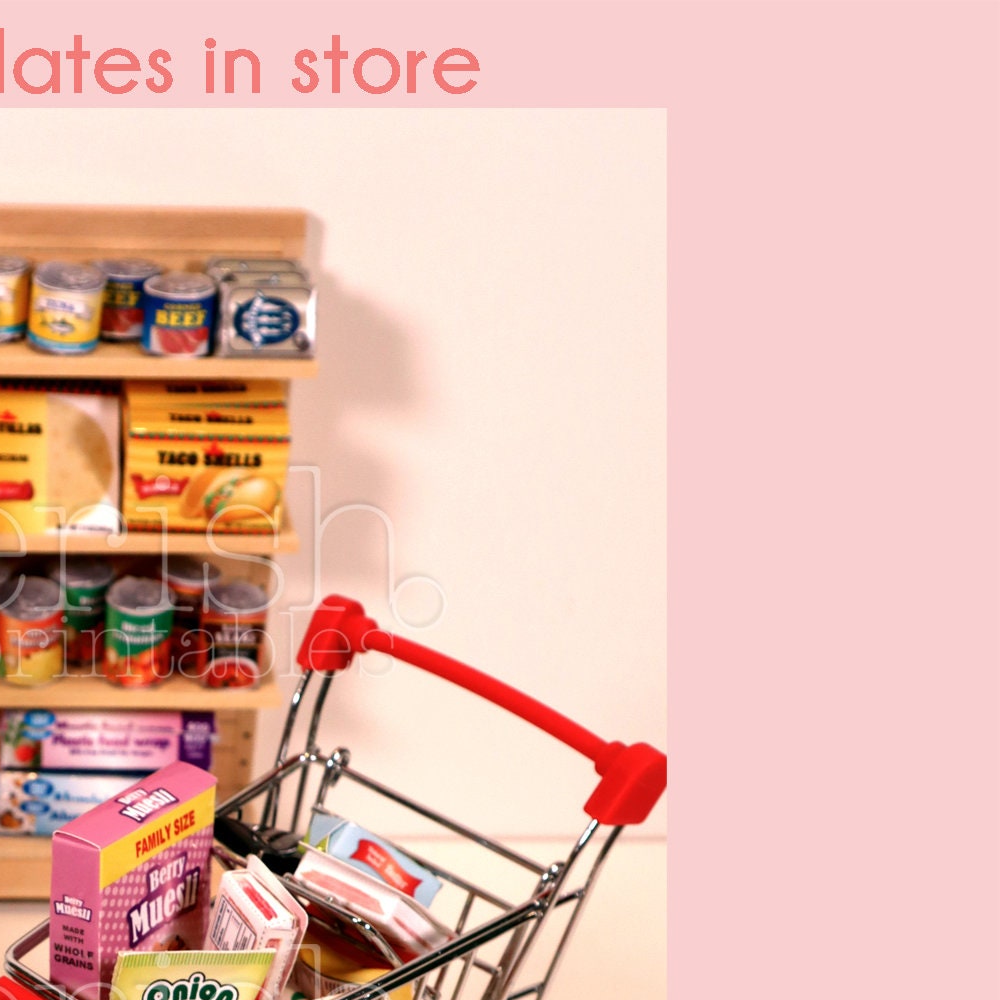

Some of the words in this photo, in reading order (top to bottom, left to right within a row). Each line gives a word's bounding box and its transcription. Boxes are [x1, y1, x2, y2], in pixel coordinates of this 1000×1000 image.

[158, 450, 198, 466] TACO
[203, 450, 262, 468] SHELLS
[121, 788, 178, 822] Muesli
[135, 823, 172, 859] FAMILY
[174, 810, 196, 836] SIZE
[149, 854, 187, 893] Berry
[55, 901, 92, 922] Muesli
[129, 870, 199, 944] Muesli
[62, 924, 85, 936] MADE
[63, 934, 84, 945] WITH
[54, 954, 94, 971] GRAINS
